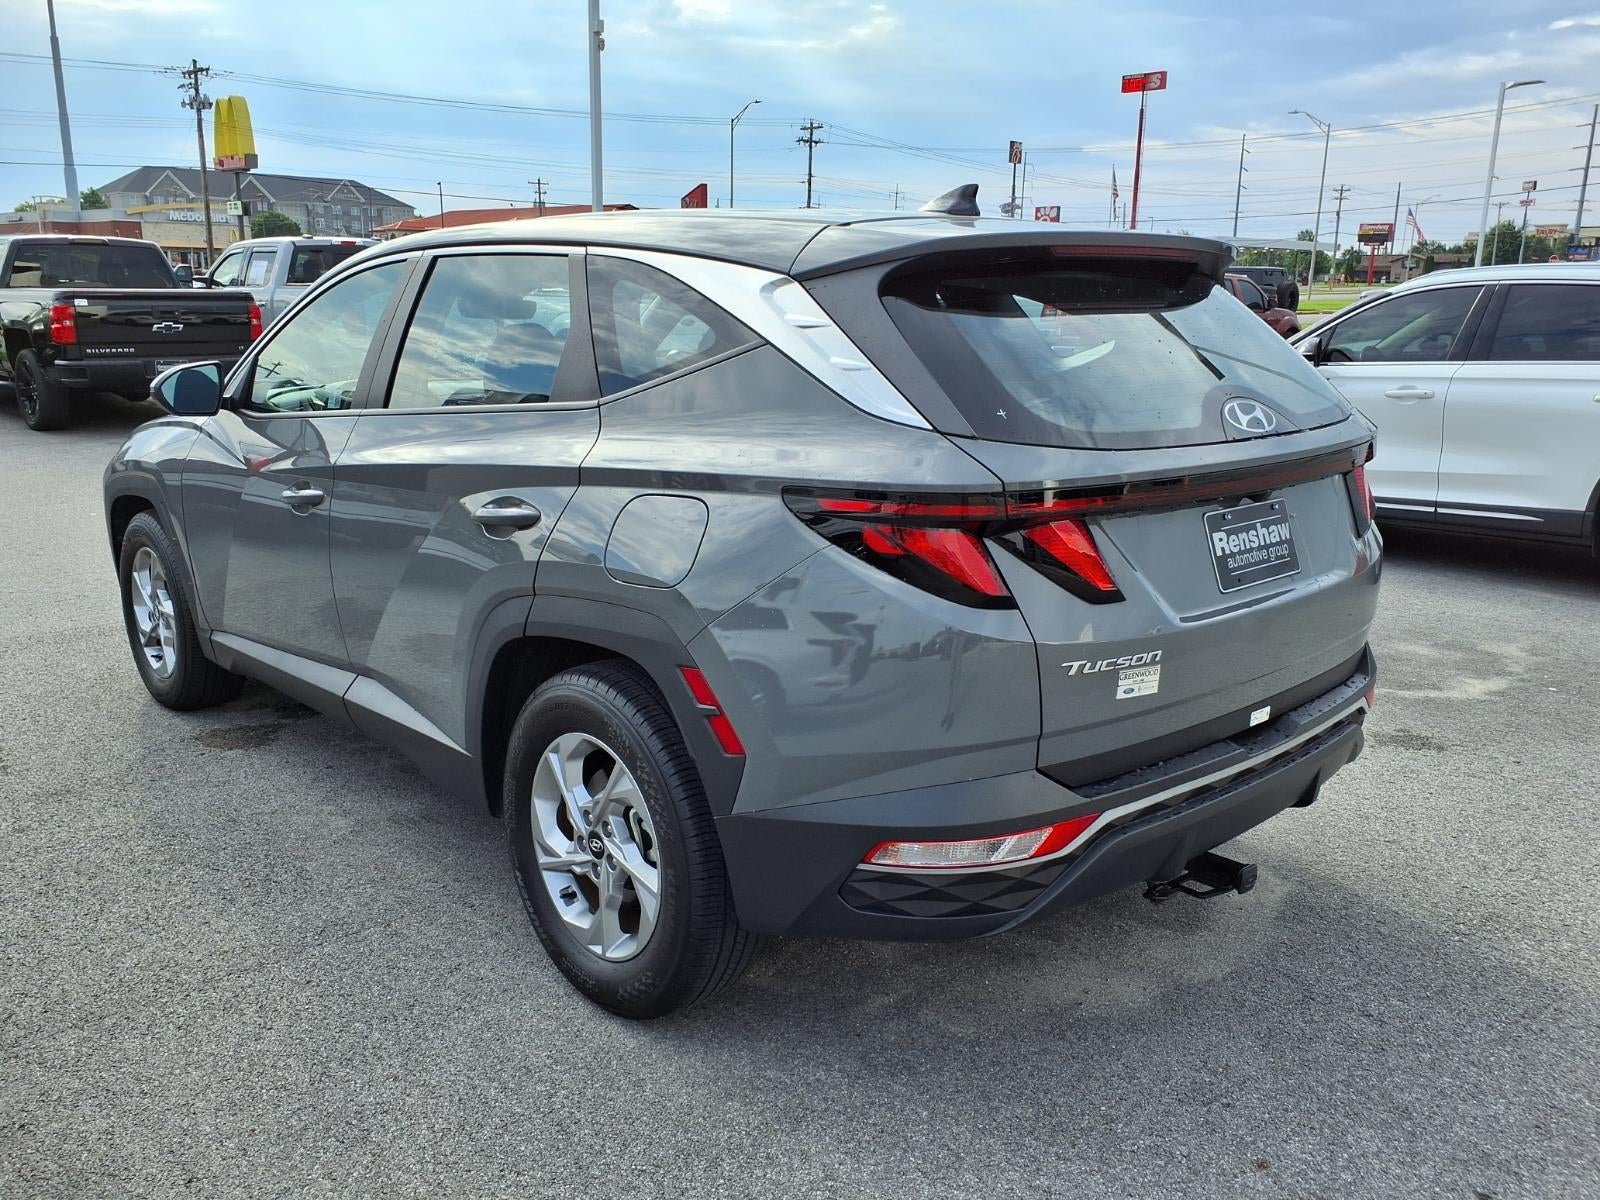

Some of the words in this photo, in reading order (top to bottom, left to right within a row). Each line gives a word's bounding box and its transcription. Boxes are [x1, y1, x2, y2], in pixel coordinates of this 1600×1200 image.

[1212, 522, 1290, 557] Renshaw
[1227, 547, 1268, 569] automotive
[1268, 543, 1289, 561] group
[1119, 668, 1159, 681] GREENWOOD
